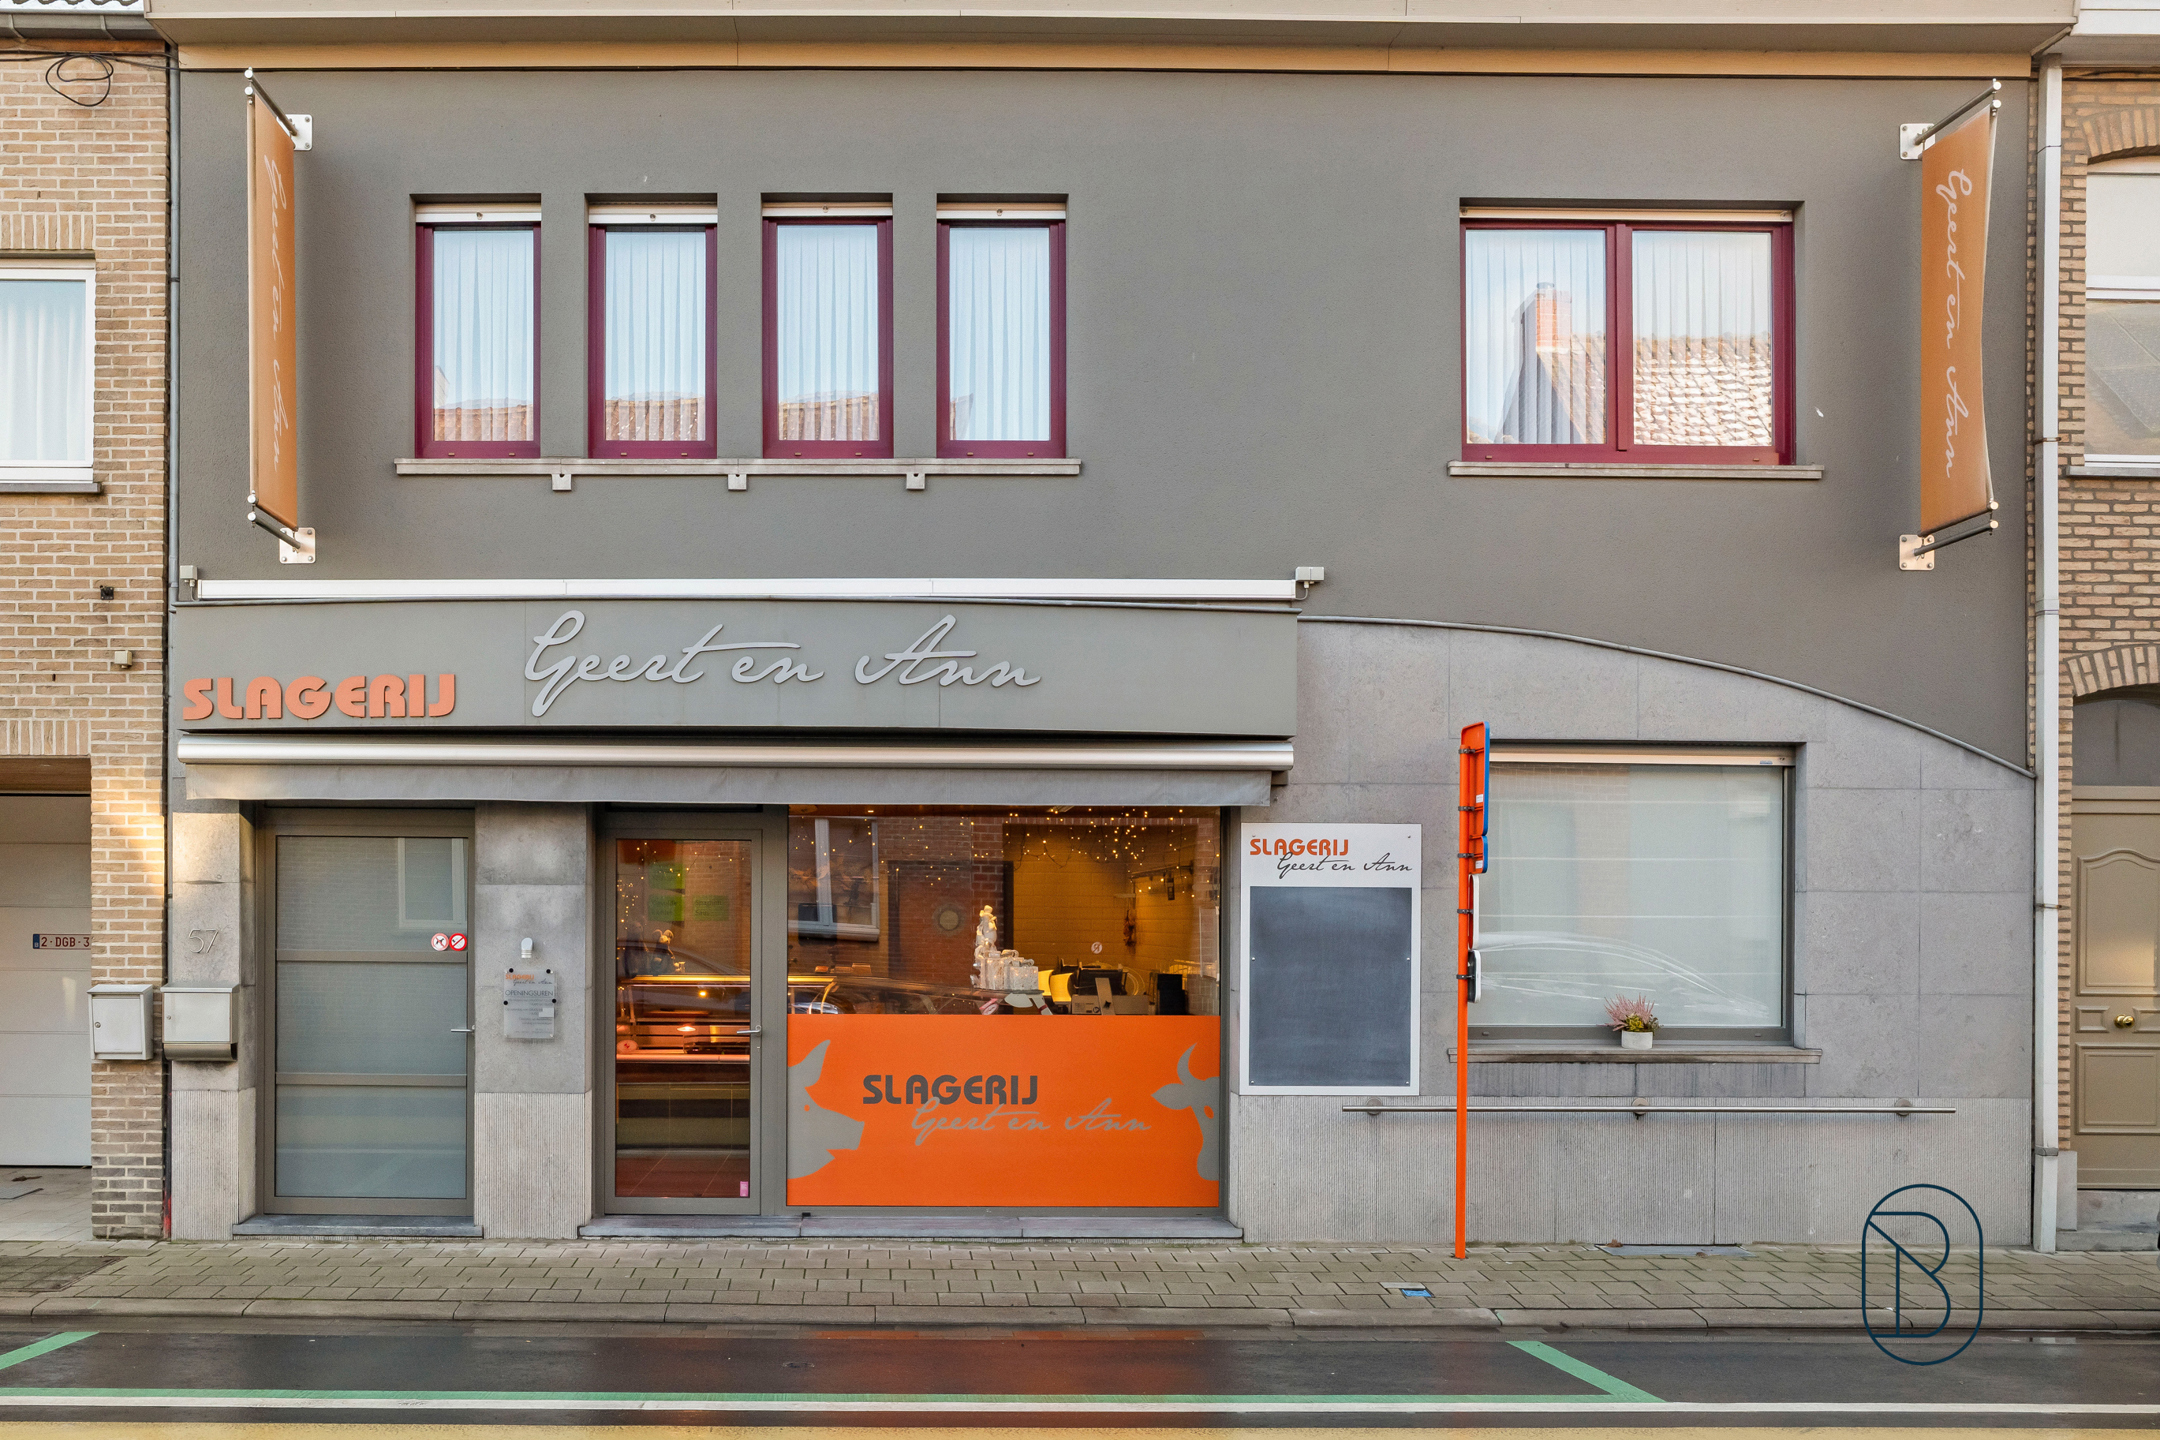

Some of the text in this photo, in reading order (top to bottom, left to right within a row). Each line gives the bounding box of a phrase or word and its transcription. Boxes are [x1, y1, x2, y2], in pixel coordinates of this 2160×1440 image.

[264, 155, 289, 472] Geert en Ann
[1936, 168, 1973, 478] Geert en Ann
[524, 609, 1042, 718] Geert en Ann
[182, 673, 457, 721] SLAGERIJ
[1249, 838, 1349, 856] SLAGERIJ
[1276, 851, 1413, 880] Geert en Ann
[188, 928, 219, 953] 57
[504, 989, 554, 997] OPENINGSUREN
[862, 1074, 1038, 1105] SLAGERIJ
[911, 1096, 1152, 1146] Geert en Ann
